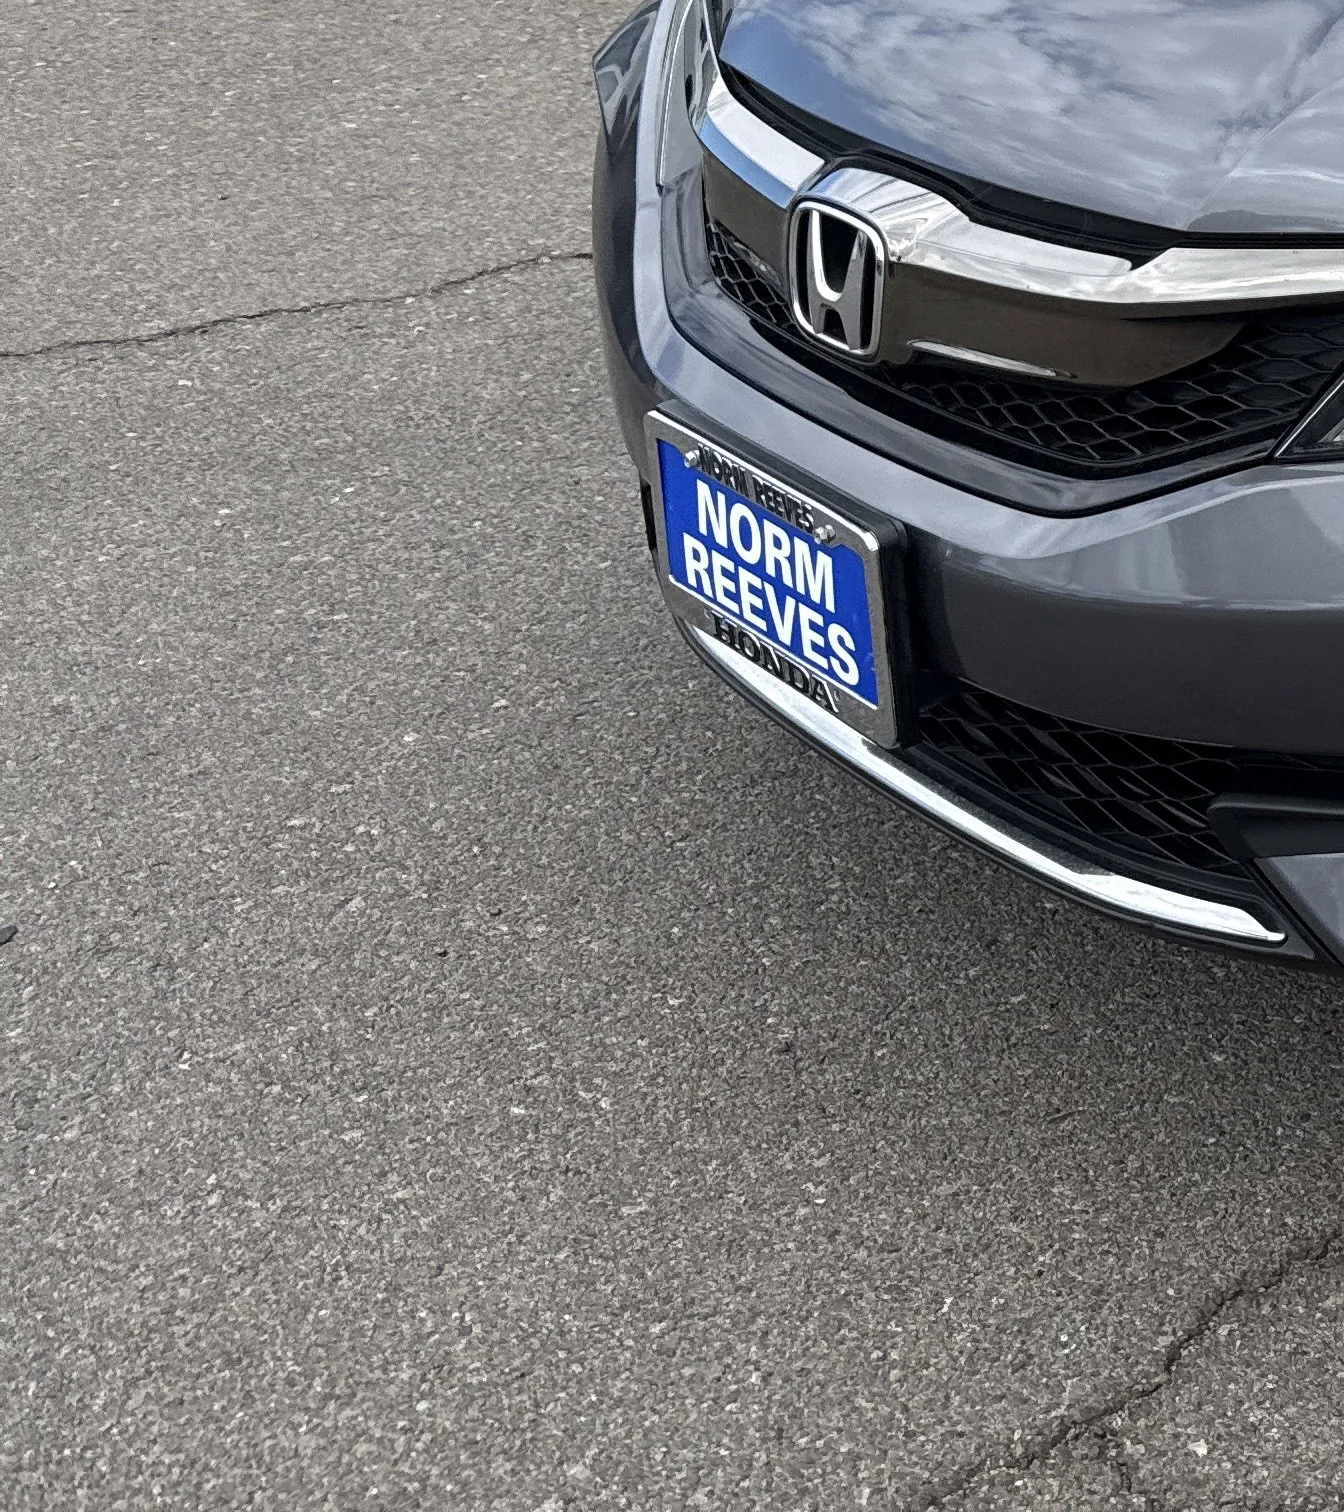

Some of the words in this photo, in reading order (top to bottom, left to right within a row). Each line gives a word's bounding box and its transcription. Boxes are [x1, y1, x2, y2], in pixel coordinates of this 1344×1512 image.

[696, 478, 836, 614] NORM
[752, 474, 815, 535] REEVES
[682, 531, 860, 687] REEVES
[710, 609, 839, 714] HONDA
